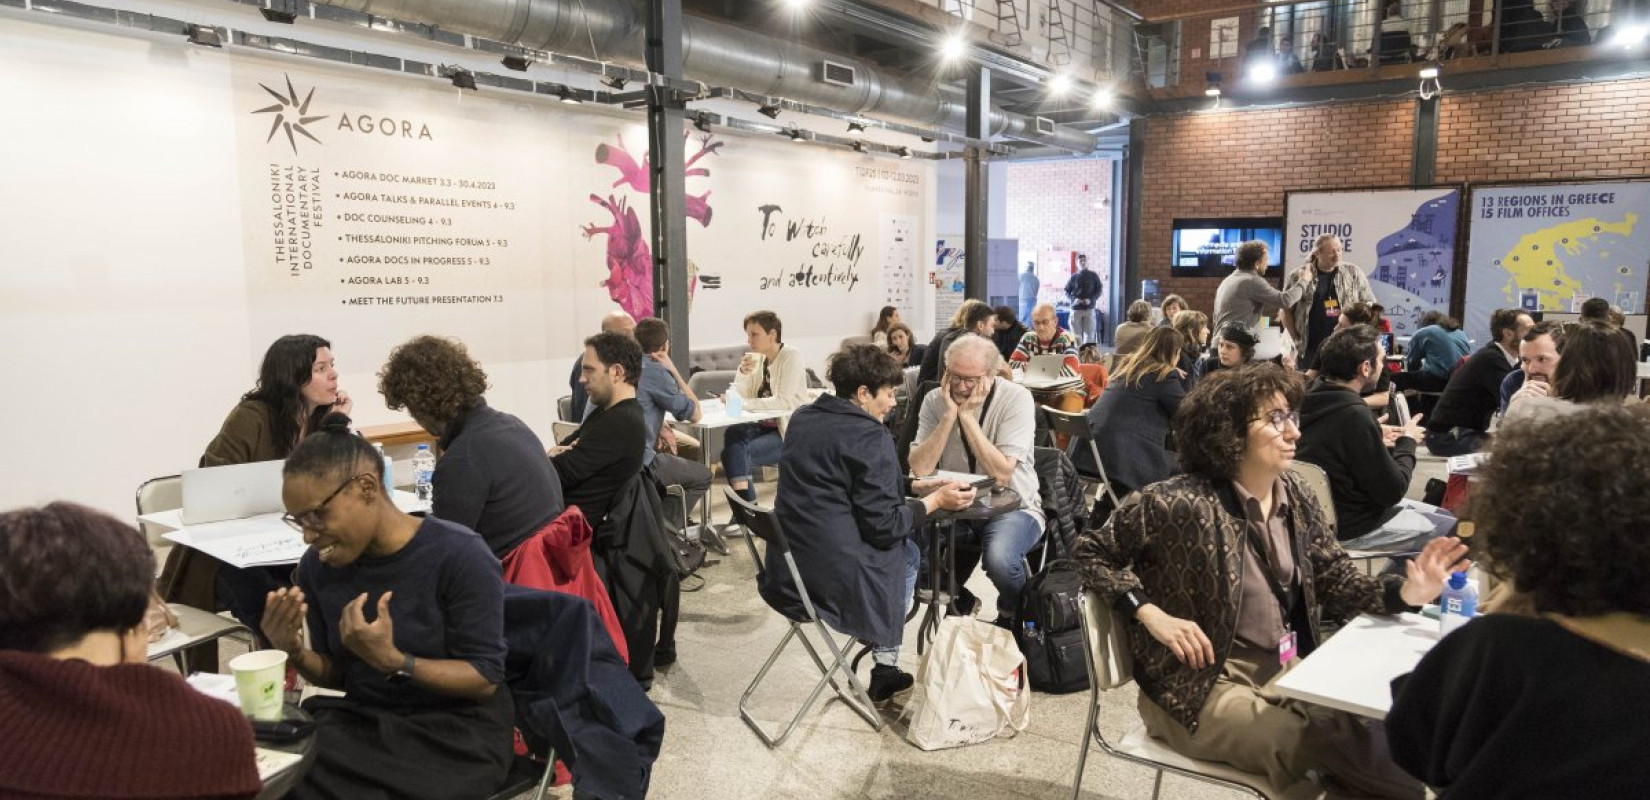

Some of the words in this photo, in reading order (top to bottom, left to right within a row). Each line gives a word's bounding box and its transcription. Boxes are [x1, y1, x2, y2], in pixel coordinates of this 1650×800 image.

[337, 112, 433, 141] AGORA
[342, 171, 377, 180] AGORA
[379, 173, 400, 182] DOC
[402, 176, 437, 186] MARKET
[311, 167, 323, 227] FESTIVAL
[343, 191, 378, 201] AGORA
[380, 194, 408, 203] TALKS
[410, 196, 416, 204] &
[418, 196, 459, 207] PARALLEL
[461, 200, 491, 209] EVENTS
[1481, 196, 1494, 207] 13
[1498, 195, 1547, 207] REGIONS
[1551, 194, 1564, 205] IN
[1568, 192, 1616, 204] GREECE
[270, 163, 286, 263] THESSALONIKI
[297, 166, 313, 270] DOCUMENTARY
[344, 213, 365, 222] DOC
[367, 214, 426, 225] COUNSELING
[1481, 207, 1494, 218] 15
[1497, 207, 1523, 218] FILM
[1527, 205, 1570, 217] OFFICES
[284, 165, 300, 277] INTERNATIONAL
[758, 203, 783, 241] To
[1300, 223, 1352, 238] STUDIO
[345, 233, 411, 245] THESSALONIKI
[413, 236, 453, 246] PITCHING
[455, 238, 485, 247] FORUM
[347, 256, 381, 264] AGORA
[384, 256, 409, 264] DOCS
[411, 256, 420, 264] IN
[423, 257, 466, 266] PROGRESS
[348, 276, 382, 285] AGORA
[385, 276, 402, 285] LAB
[417, 276, 430, 285] 9.3
[760, 268, 784, 290] and
[349, 297, 374, 305] MEET
[376, 297, 393, 305] THE
[395, 296, 430, 305] FUTURE
[432, 295, 492, 304] PRESENTATION
